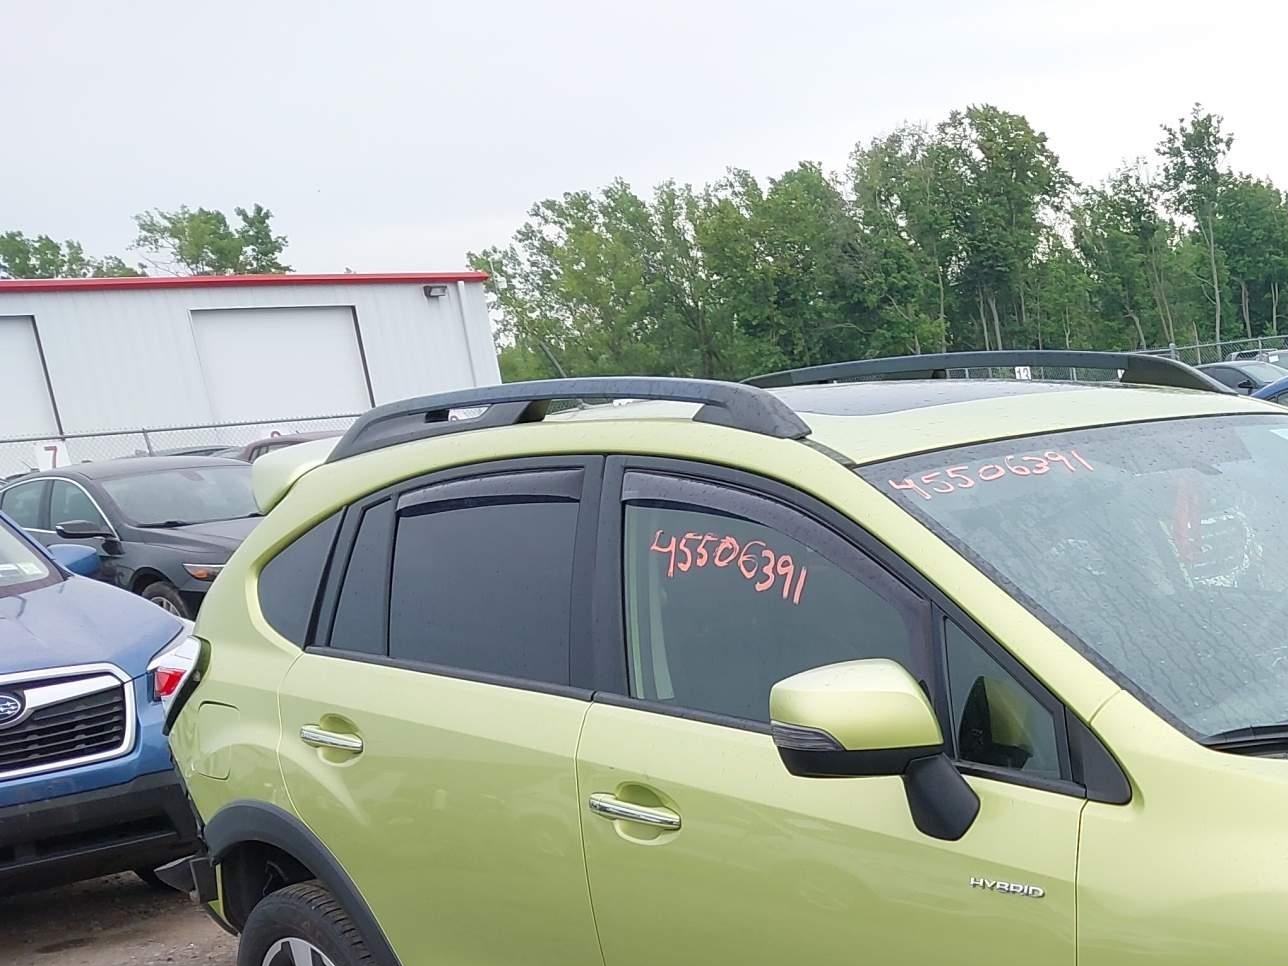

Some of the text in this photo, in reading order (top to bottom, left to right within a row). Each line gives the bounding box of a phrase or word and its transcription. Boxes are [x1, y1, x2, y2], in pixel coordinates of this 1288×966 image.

[44, 445, 57, 469] 7
[888, 451, 1095, 500] 45506391
[650, 529, 808, 606] 45506391
[969, 876, 1046, 898] HYBRID
